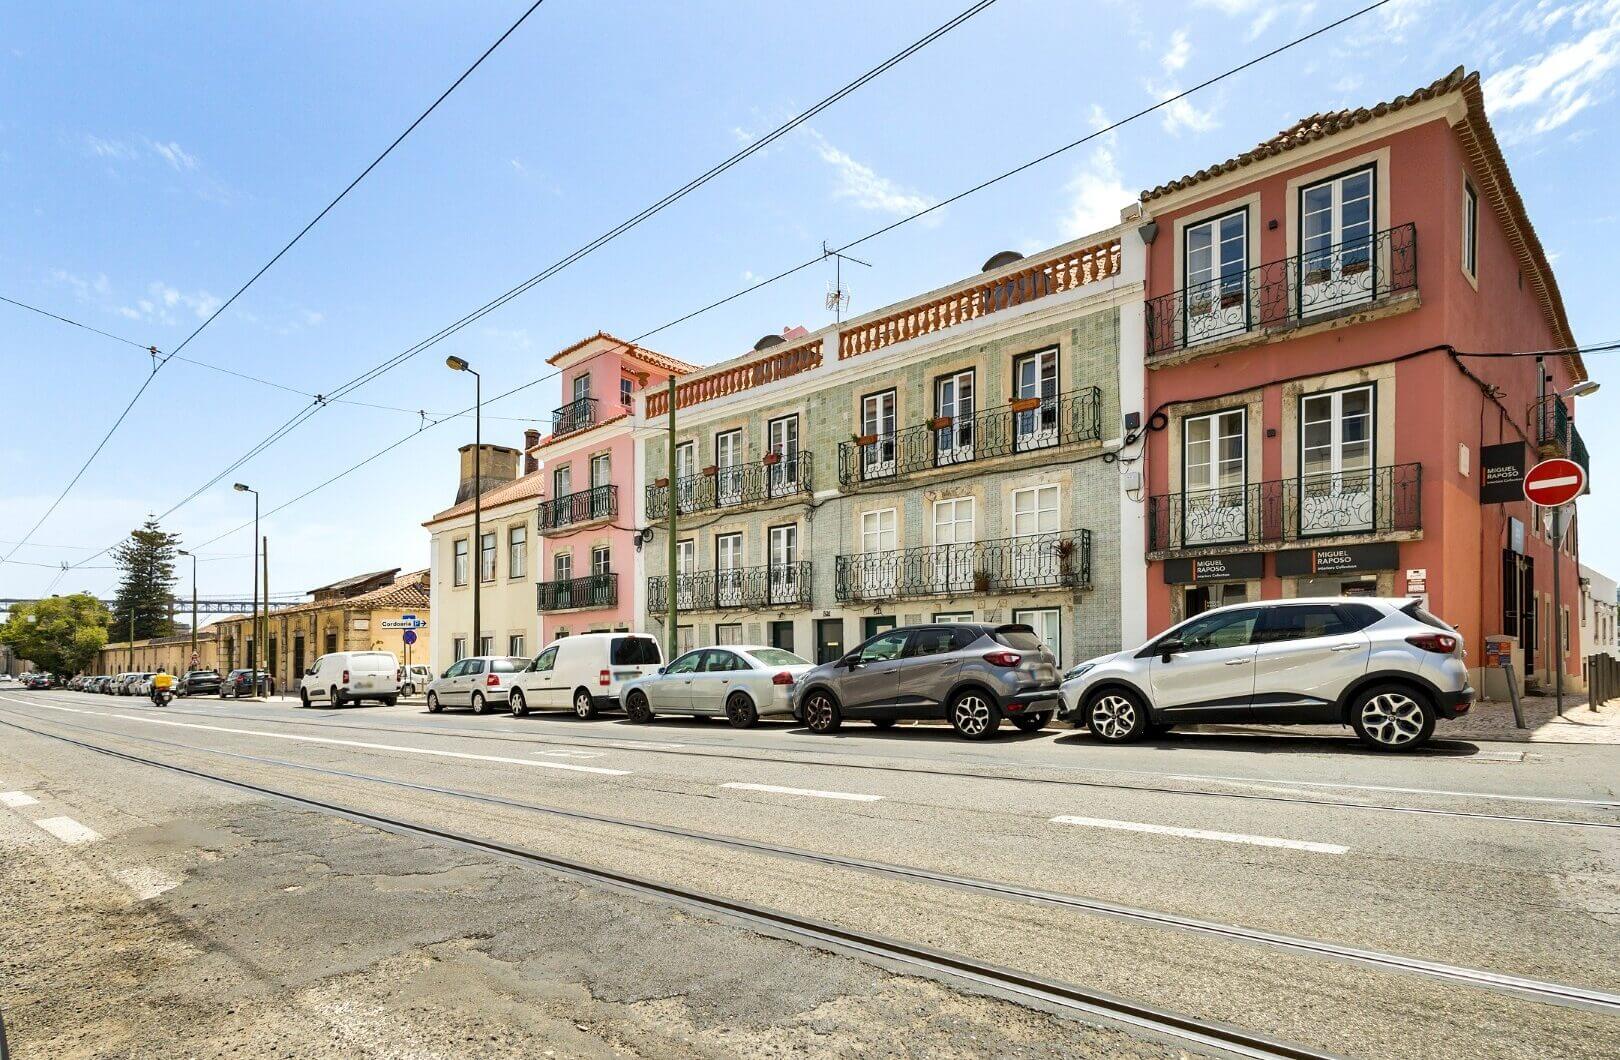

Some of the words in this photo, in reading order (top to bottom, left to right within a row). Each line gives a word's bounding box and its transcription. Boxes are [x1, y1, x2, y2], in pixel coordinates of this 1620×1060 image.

[1487, 471, 1519, 479] RAPOSO
[1317, 550, 1348, 558] MIGUEL
[1317, 557, 1352, 565] RAPOSO
[1197, 565, 1226, 573] RAPOSO
